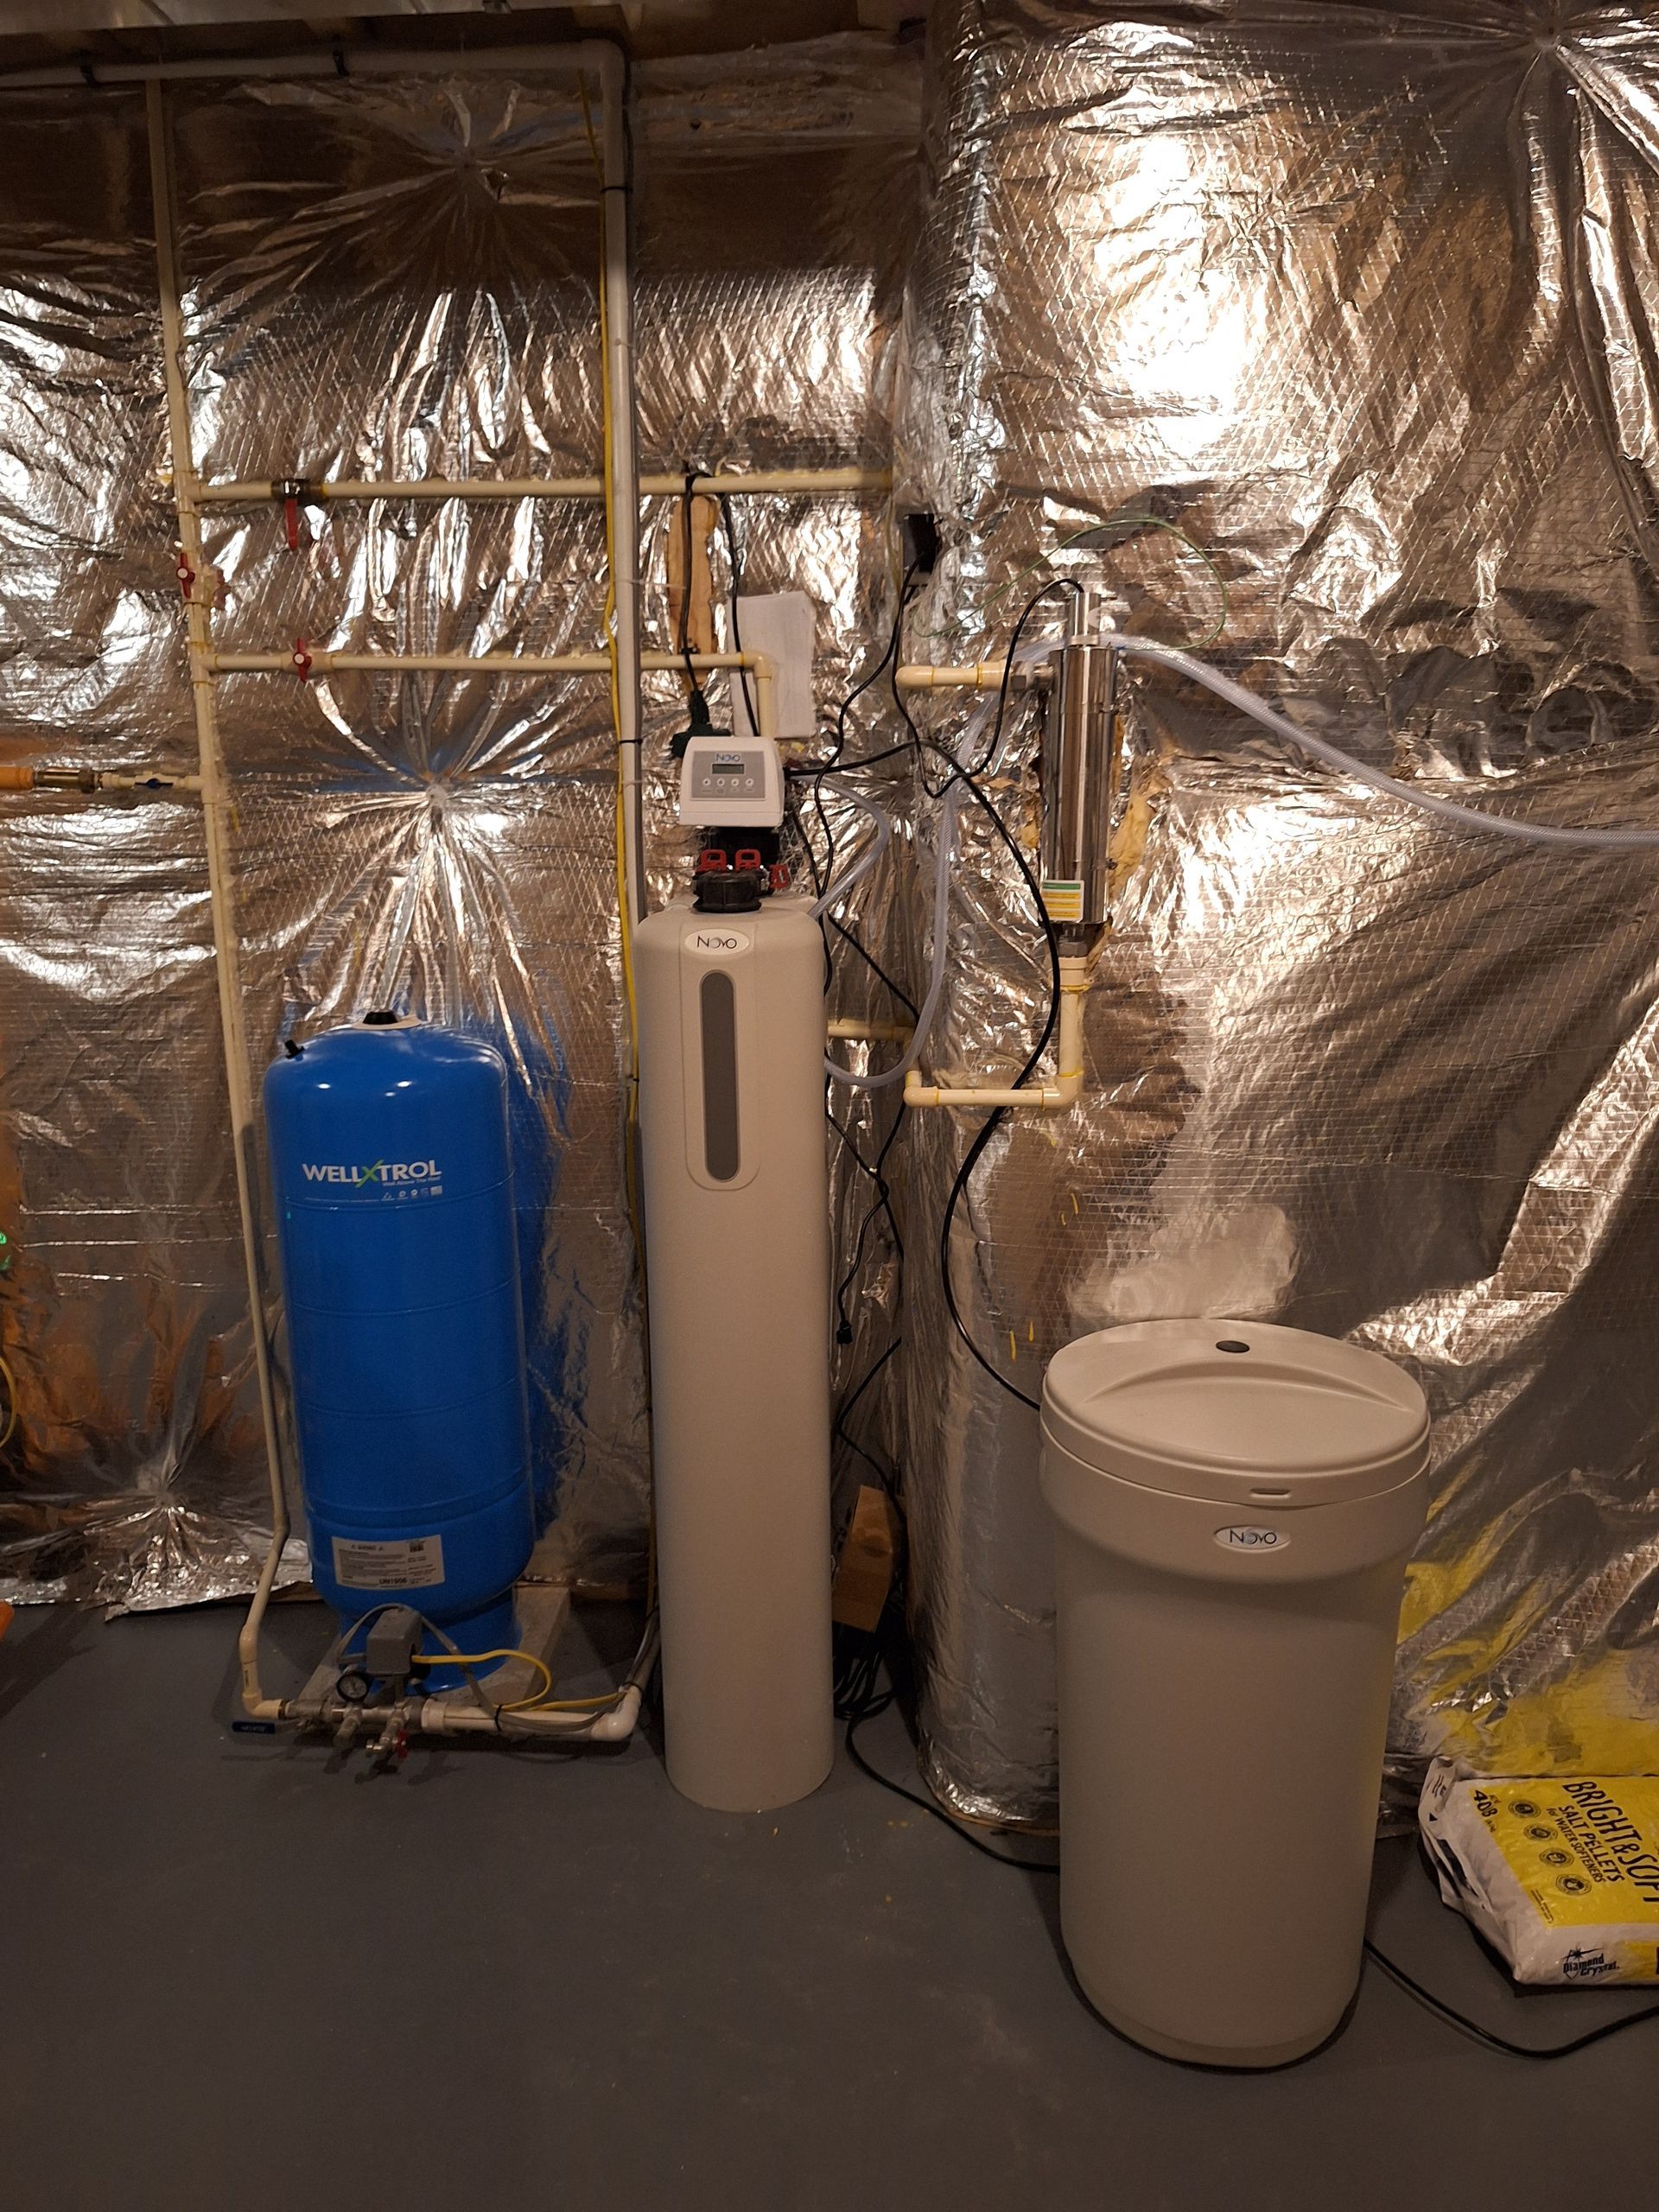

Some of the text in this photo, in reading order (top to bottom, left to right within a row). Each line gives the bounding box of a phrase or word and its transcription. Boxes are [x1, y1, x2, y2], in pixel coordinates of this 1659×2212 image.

[1555, 1817, 1579, 1843] WATER
[1570, 1841, 1607, 1884] SOFTENERS
[1558, 1805, 1590, 1829] SALT
[1579, 1833, 1625, 1882] PELLETS
[1561, 1781, 1643, 1842] BRIGHT
[1610, 1842, 1641, 1854] &
[1563, 1954, 1605, 1974] Diamond
